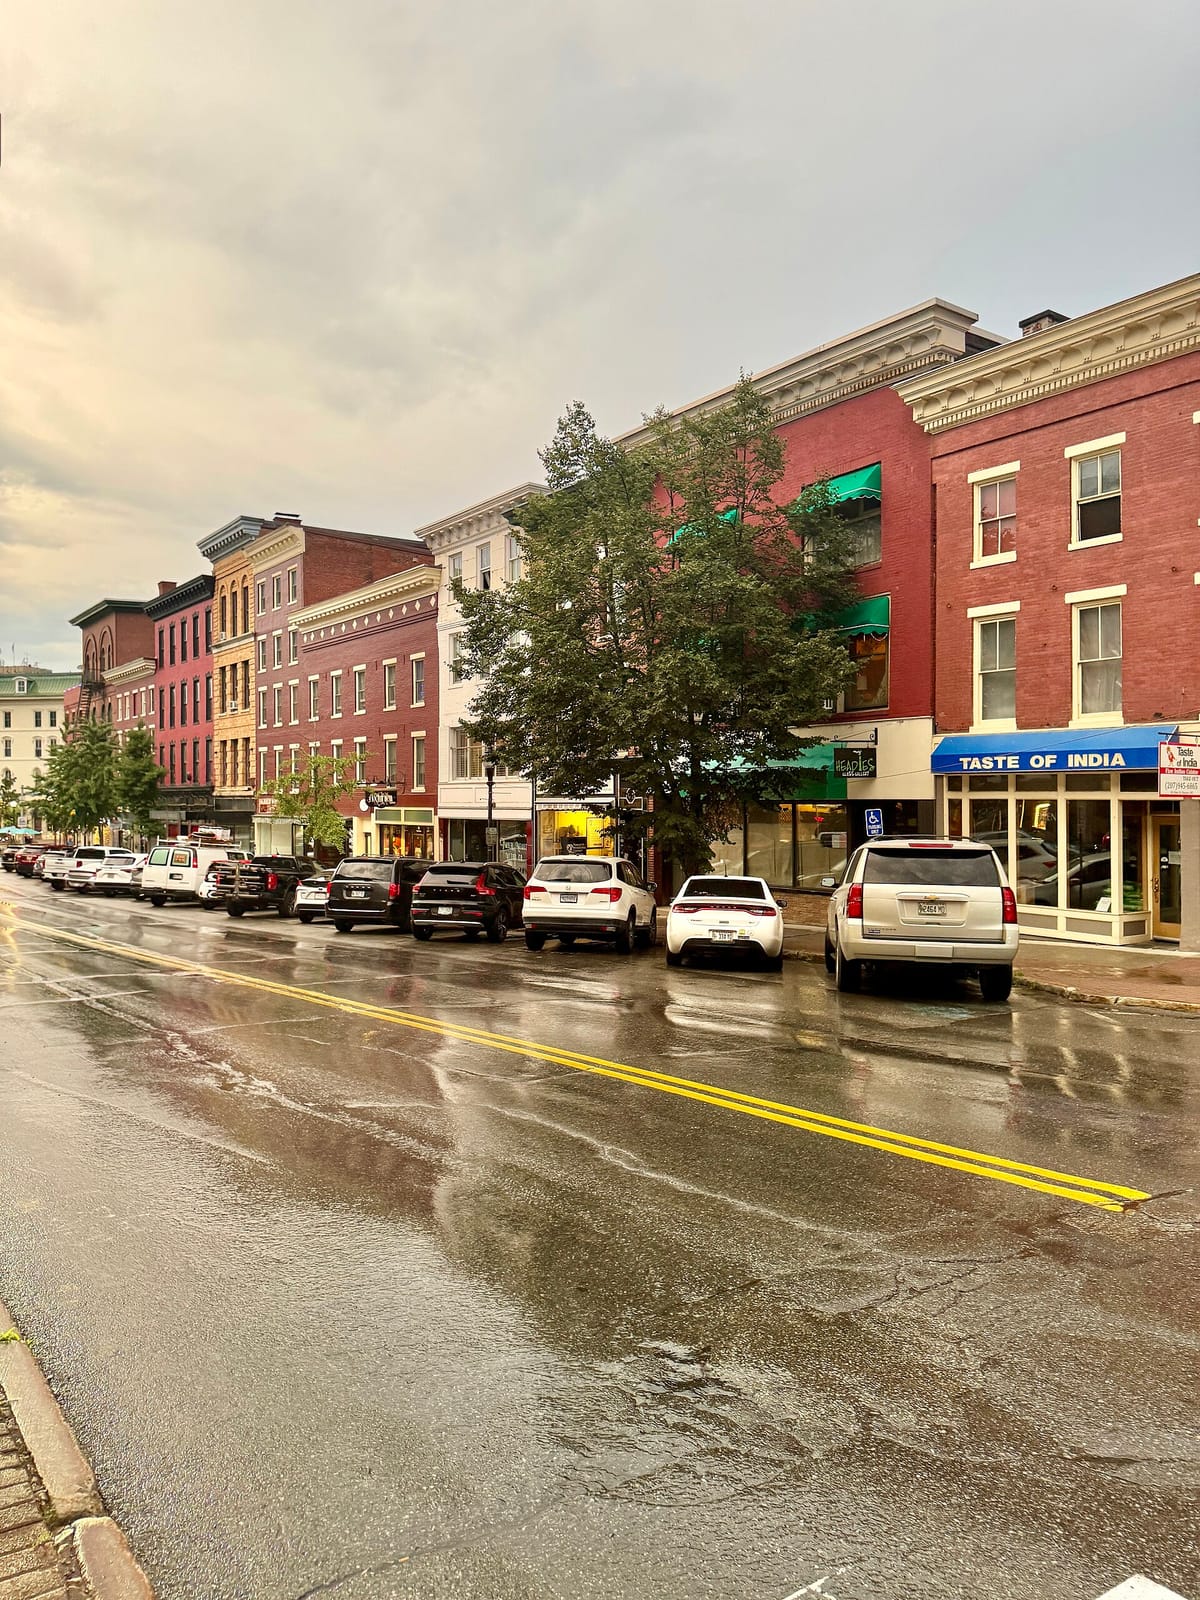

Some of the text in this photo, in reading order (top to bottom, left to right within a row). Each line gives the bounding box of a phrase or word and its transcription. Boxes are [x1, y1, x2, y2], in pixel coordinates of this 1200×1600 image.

[1176, 746, 1194, 757] Taste
[835, 756, 876, 772] HEADIES
[960, 753, 1126, 770] TASTE OF INDIA
[1182, 757, 1198, 768] India
